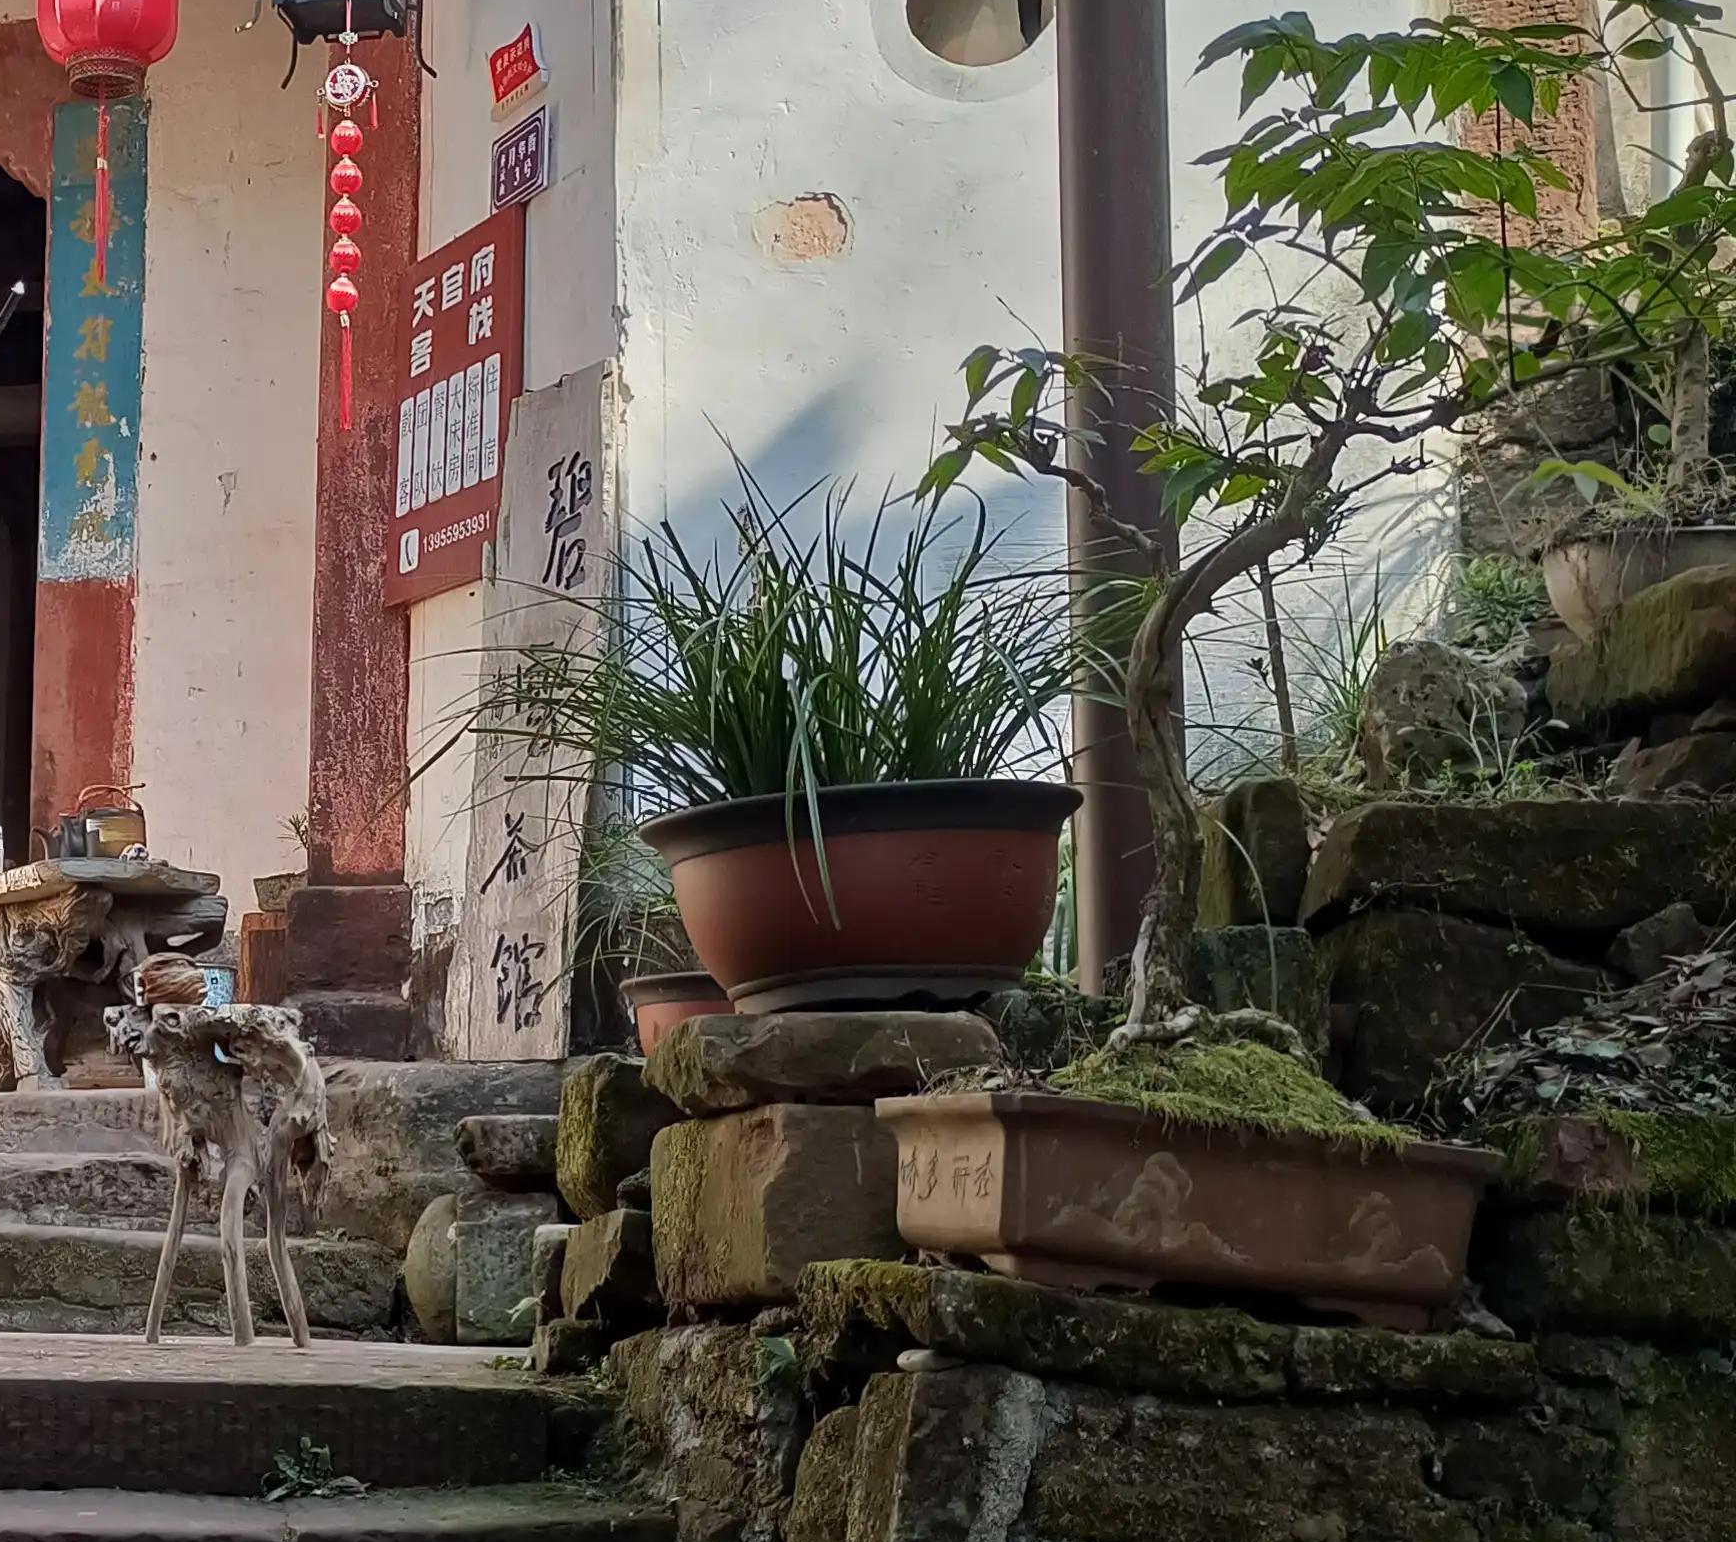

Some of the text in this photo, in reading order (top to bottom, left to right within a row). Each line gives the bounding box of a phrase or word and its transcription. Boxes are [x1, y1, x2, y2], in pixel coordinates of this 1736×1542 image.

[412, 243, 495, 328] 天官府
[399, 408, 412, 507] 散客
[414, 400, 429, 500] 团队
[430, 391, 445, 492] 餐饮
[447, 383, 462, 483] 大床房
[465, 374, 480, 474] 标准间
[484, 364, 498, 469] 住宿
[422, 511, 490, 554] 13955953931
